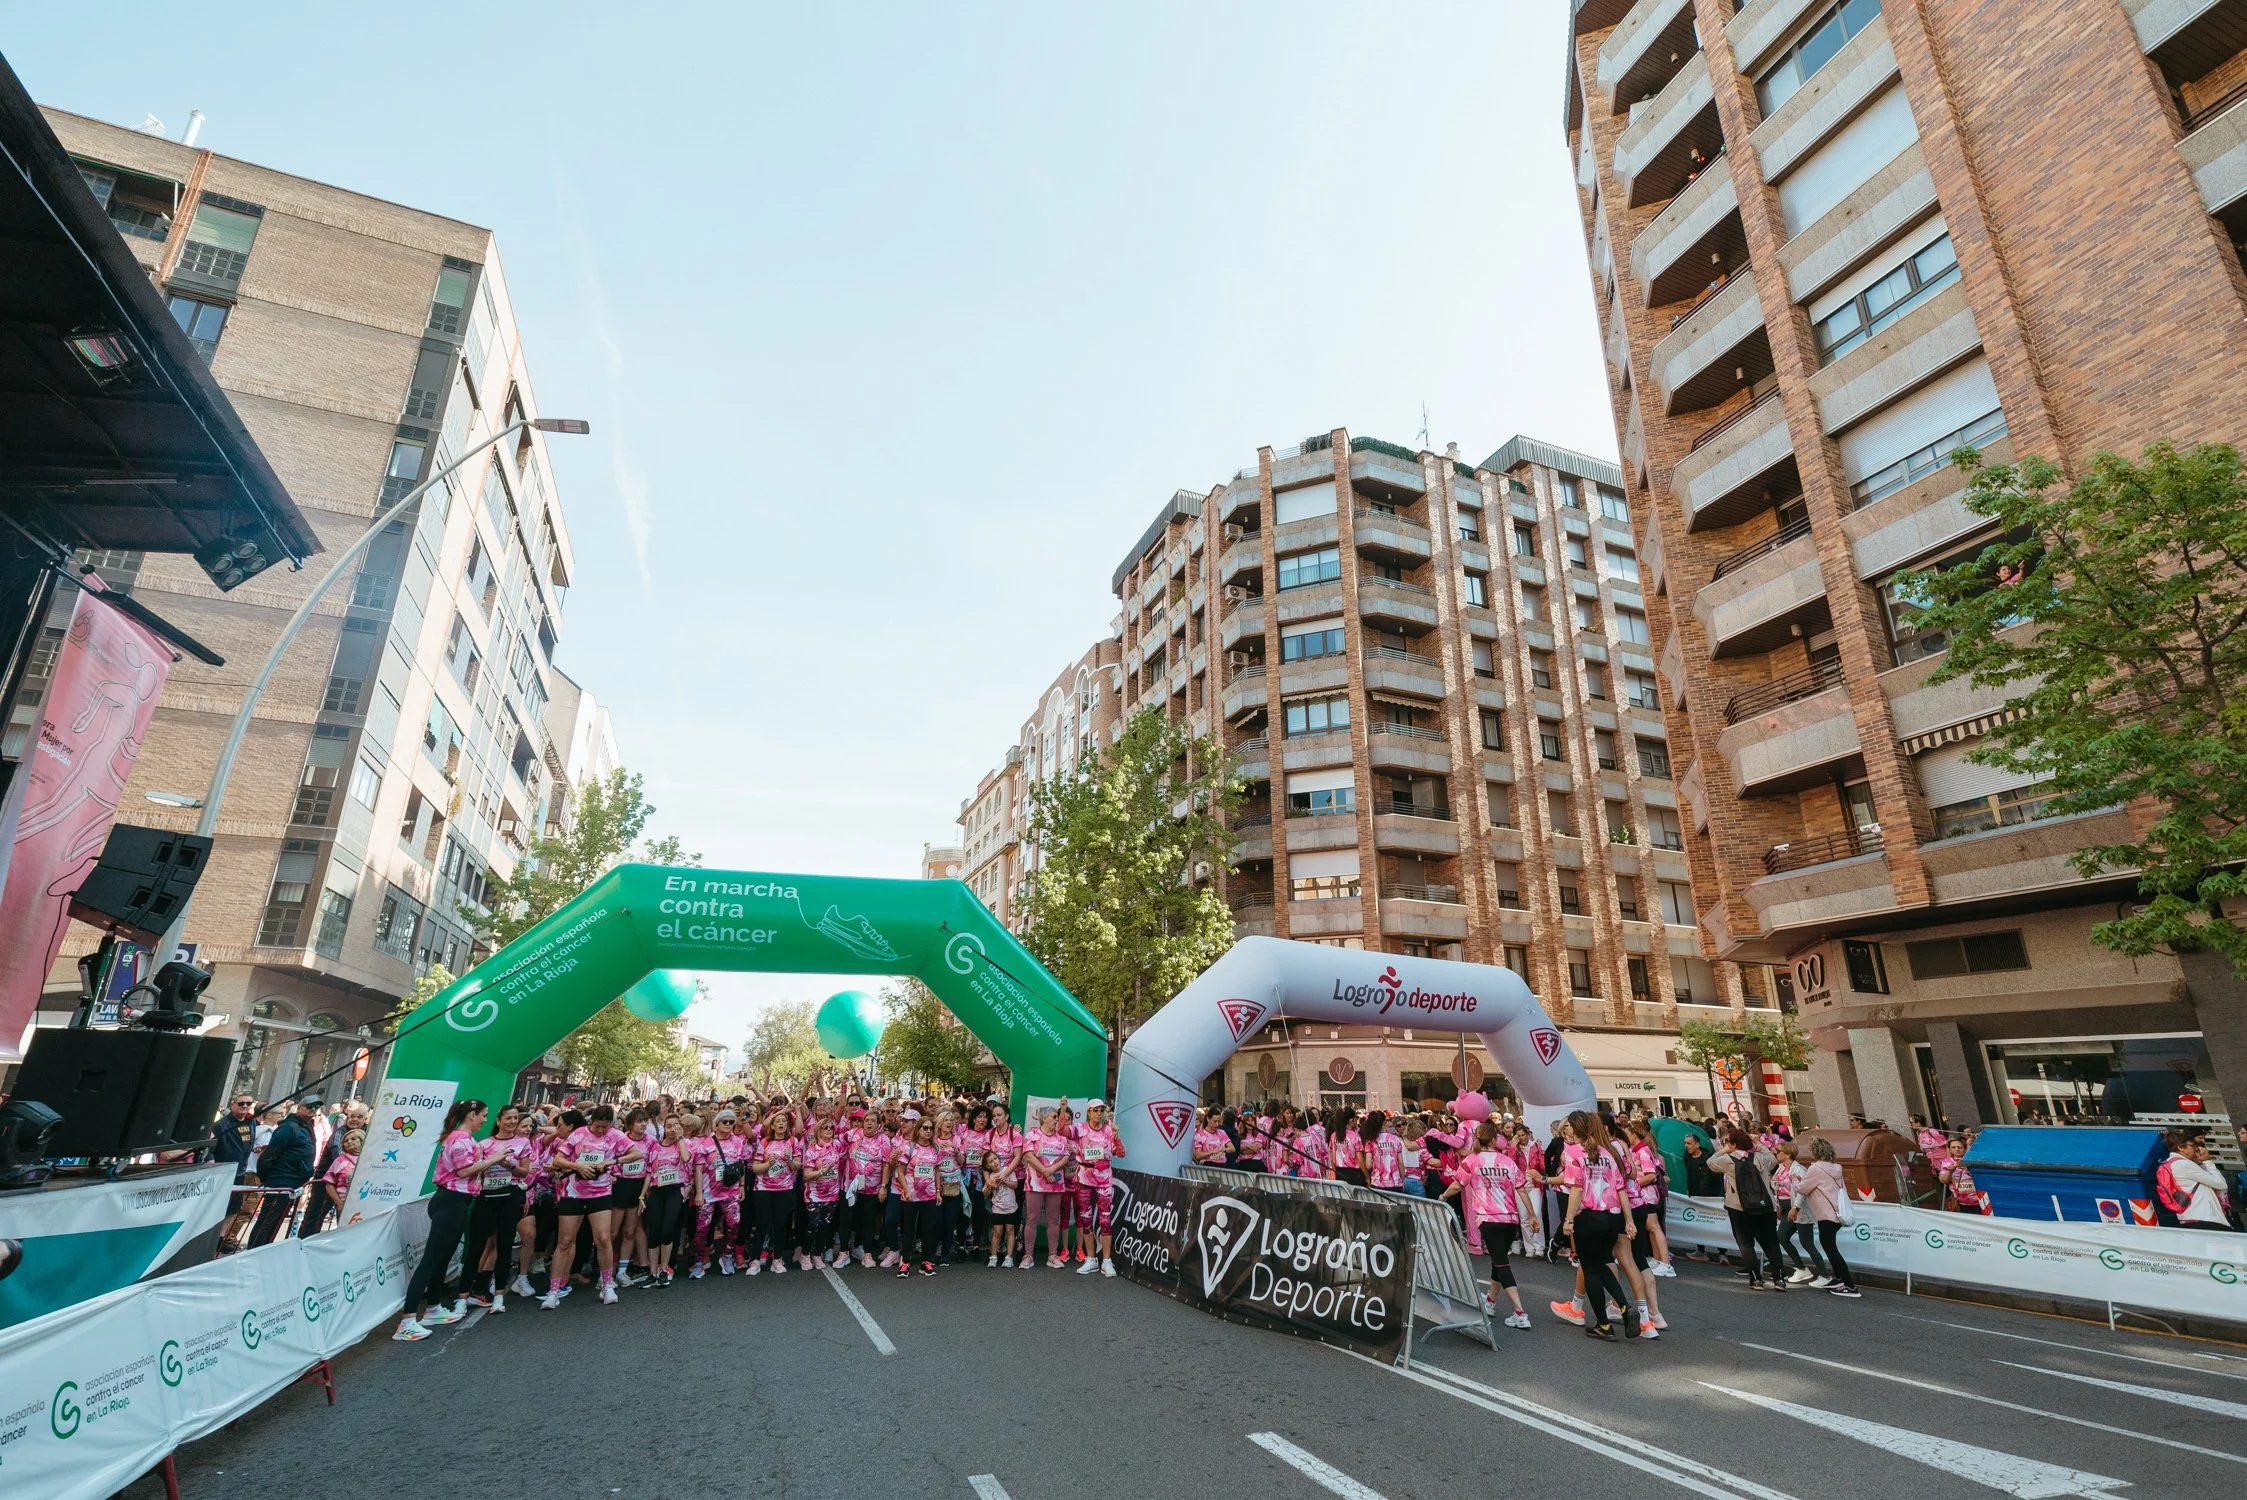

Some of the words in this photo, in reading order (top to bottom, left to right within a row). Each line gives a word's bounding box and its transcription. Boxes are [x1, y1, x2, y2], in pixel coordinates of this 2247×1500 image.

[62, 744, 74, 755] por
[664, 876, 697, 892] En
[704, 881, 798, 898] marcha
[660, 898, 744, 918] contra
[492, 942, 554, 984] asociación
[555, 906, 608, 944] española
[656, 919, 682, 938] el
[688, 921, 777, 944] cáncer
[500, 966, 540, 994] contra
[540, 956, 552, 970] el
[553, 931, 592, 961] cáncer
[508, 988, 527, 1005] en
[526, 978, 545, 993] La
[544, 956, 579, 982] Rioja
[970, 980, 983, 994] en
[982, 990, 994, 1006] La
[992, 1003, 1015, 1030] Rioja
[980, 972, 1006, 1000] contra
[1004, 999, 1015, 1009] el
[1012, 1007, 1040, 1038] cáncer
[988, 963, 1029, 1009] asociación
[1028, 1006, 1062, 1046] española
[1408, 987, 1478, 1014] deporte
[394, 1094, 406, 1106] La
[408, 1094, 444, 1110] Rioja
[584, 1154, 599, 1162] 869
[370, 1186, 402, 1196] viamed
[488, 1178, 507, 1186] 3963
[661, 1174, 676, 1182] 1031
[1124, 1194, 1179, 1236] Logroño
[1114, 1227, 1170, 1274] Deporte
[1260, 1218, 1394, 1278] Logroño
[1250, 1262, 1386, 1332] Deporte
[184, 1329, 214, 1349] asociación
[186, 1346, 204, 1362] contra
[204, 1343, 210, 1354] el
[211, 1338, 229, 1351] cáncer
[85, 1366, 124, 1391] asociación
[125, 1354, 156, 1375] española
[86, 1387, 112, 1406] contra
[112, 1384, 120, 1394] el
[120, 1374, 145, 1391] cáncer
[5, 1400, 45, 1426] española
[86, 1410, 98, 1423] en
[98, 1406, 108, 1418] La
[110, 1396, 130, 1412] Rioja
